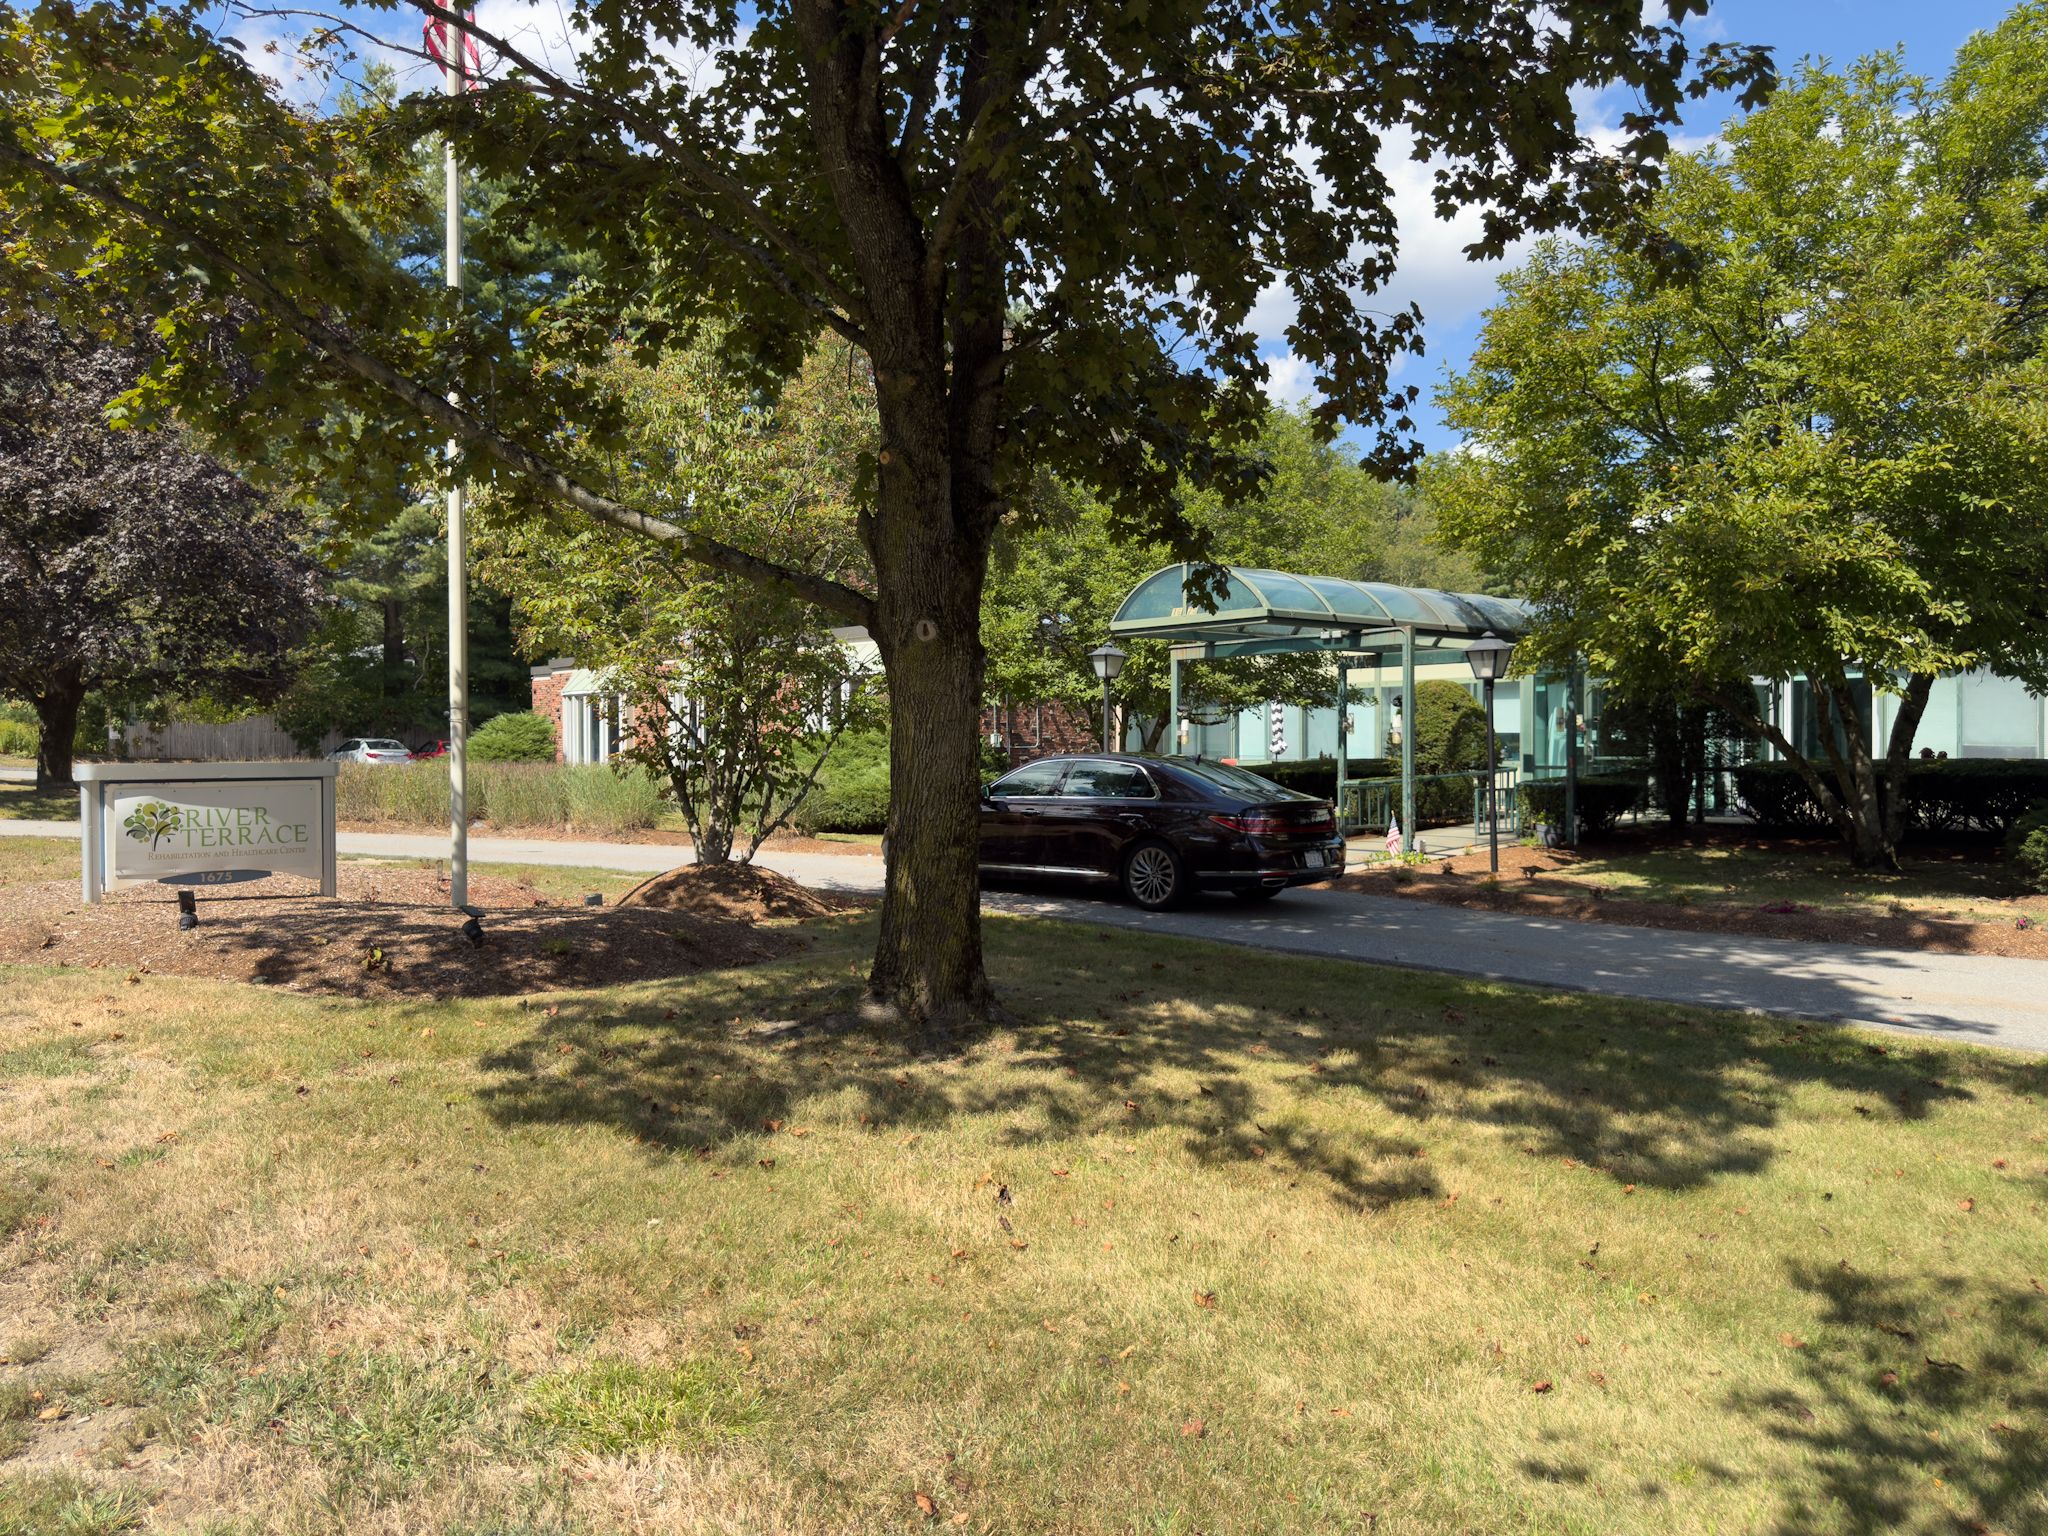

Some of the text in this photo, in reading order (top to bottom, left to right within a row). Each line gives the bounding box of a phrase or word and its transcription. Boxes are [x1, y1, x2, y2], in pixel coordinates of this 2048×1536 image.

[184, 806, 271, 828] RIVER
[180, 824, 309, 848] TERRACE
[200, 871, 232, 882] 1675
